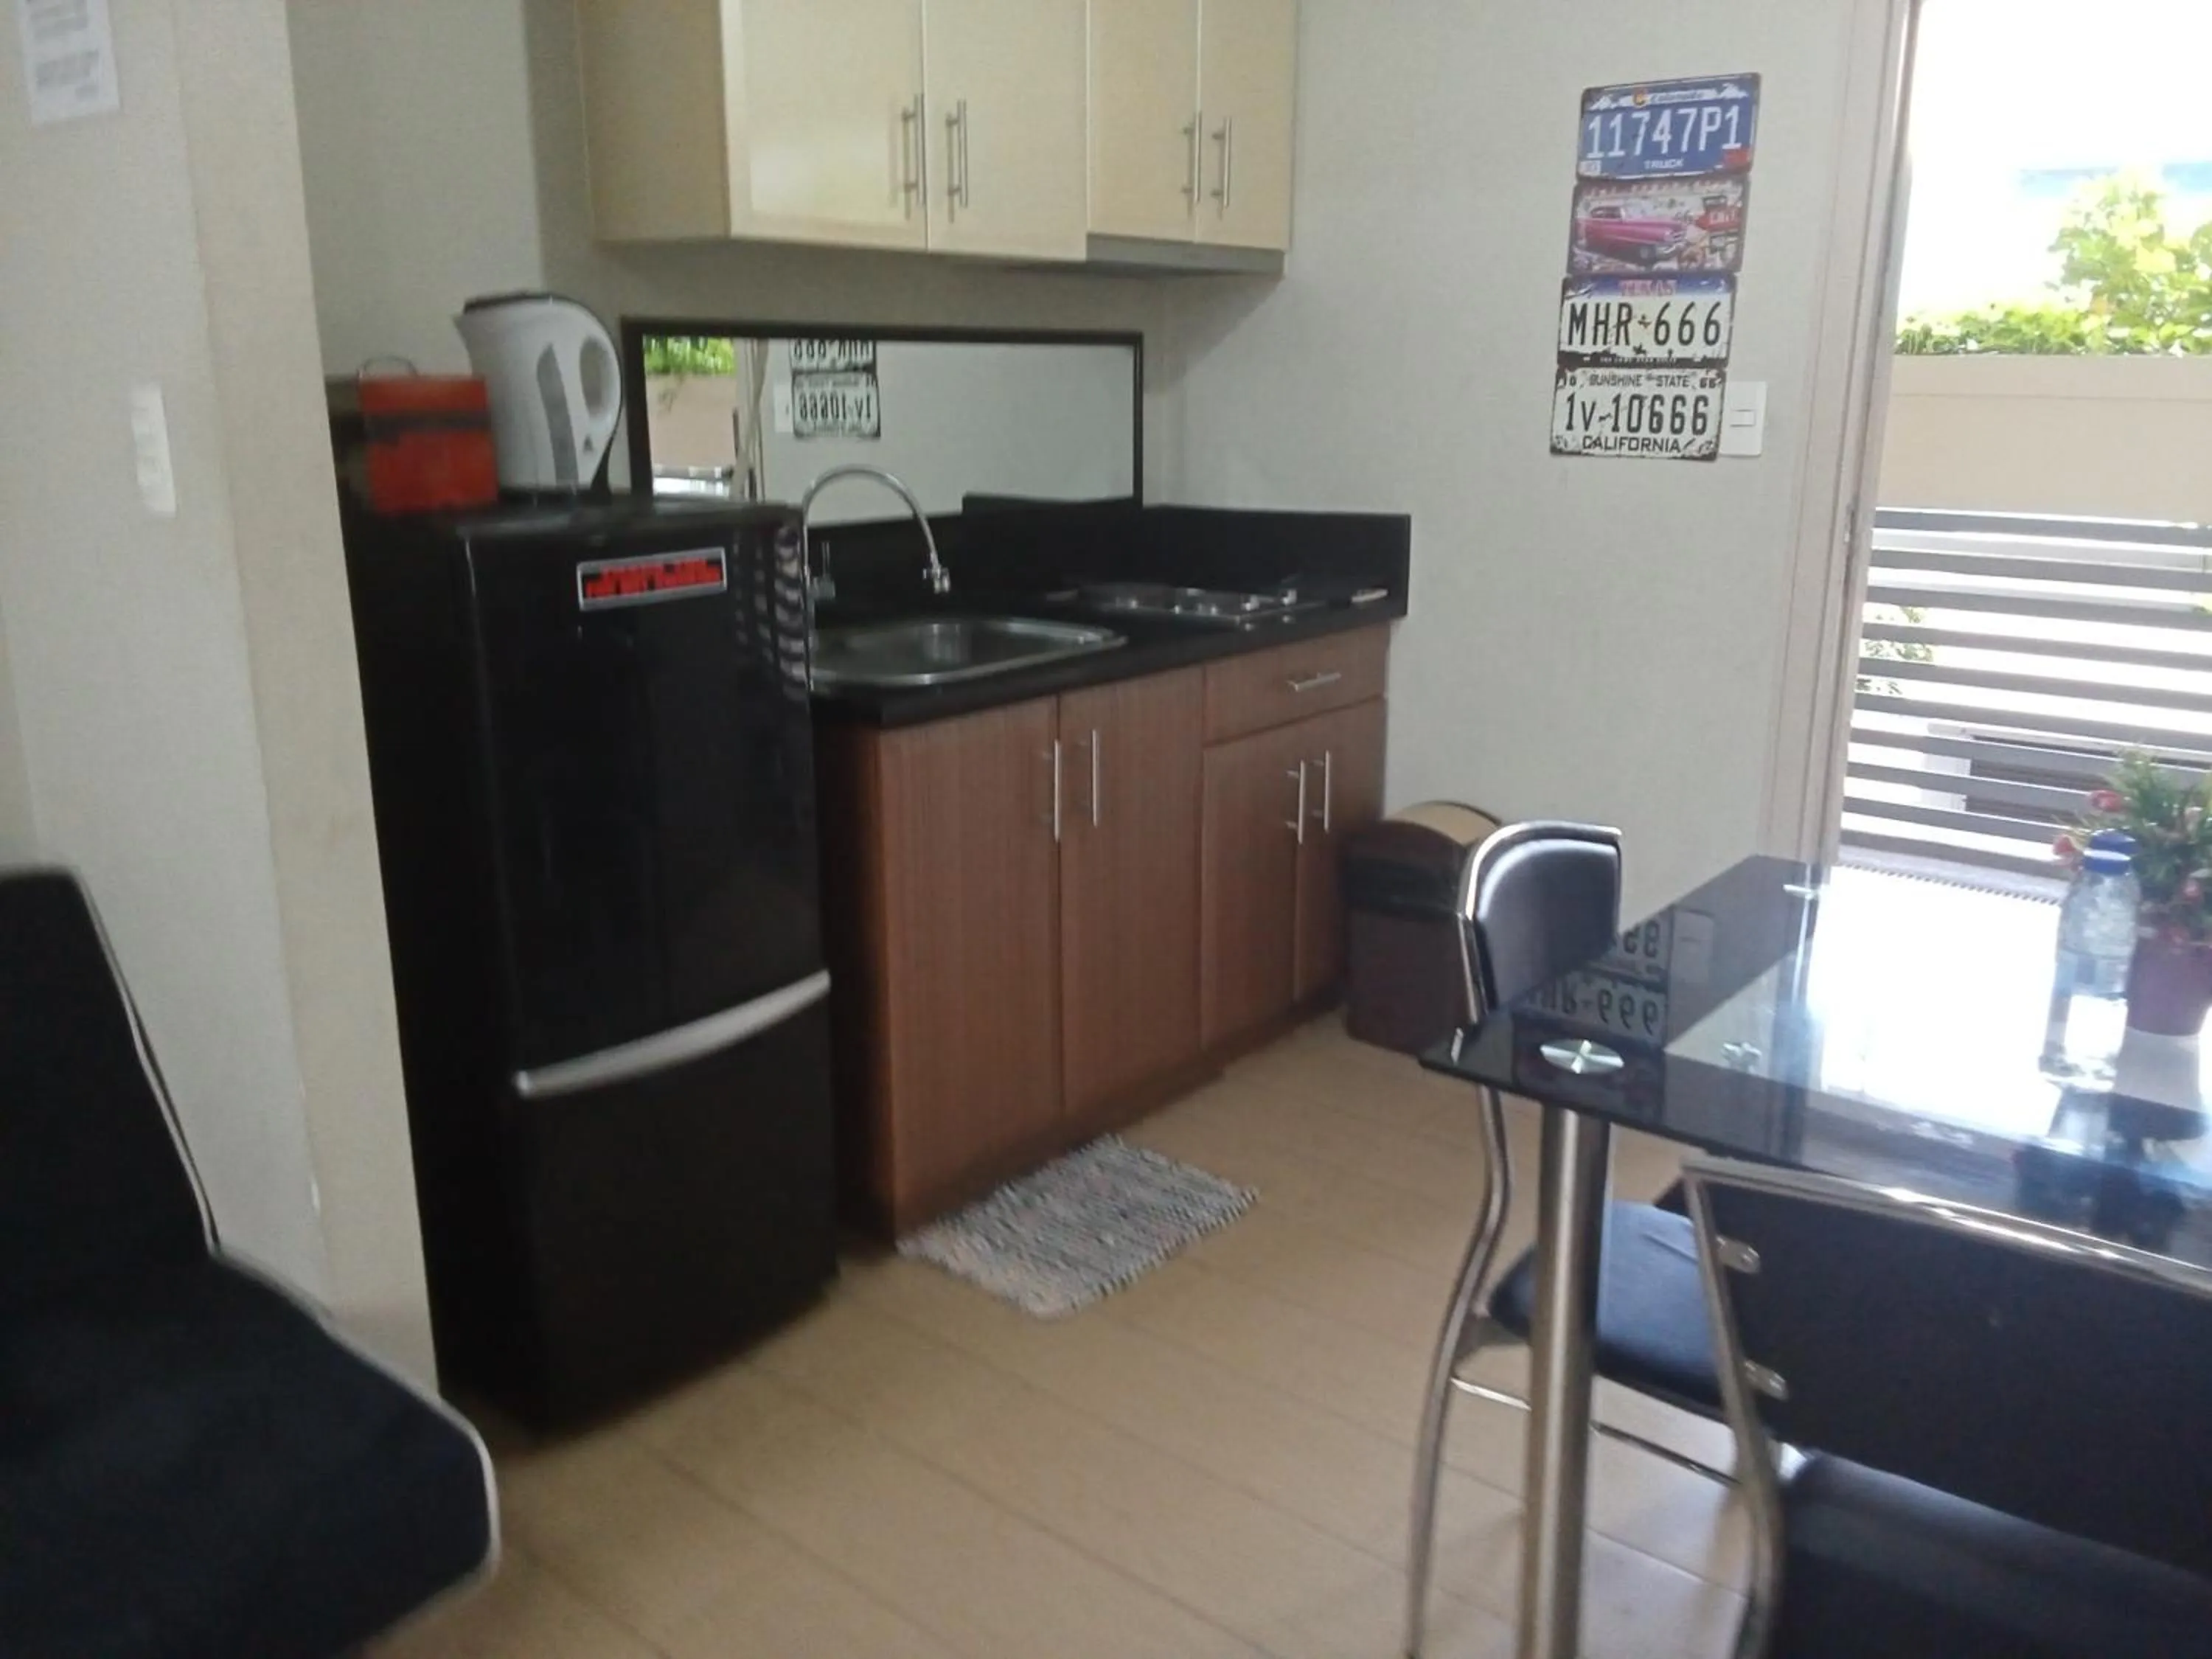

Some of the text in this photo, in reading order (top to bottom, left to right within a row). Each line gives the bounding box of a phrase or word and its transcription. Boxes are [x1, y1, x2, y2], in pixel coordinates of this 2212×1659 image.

[1586, 105, 1742, 159] 11747P1
[1644, 158, 1685, 170] TRUCK
[1589, 374, 1643, 387] SUNSHINE
[1655, 375, 1690, 388] STATE
[1582, 434, 1682, 453] CALIFORNIA
